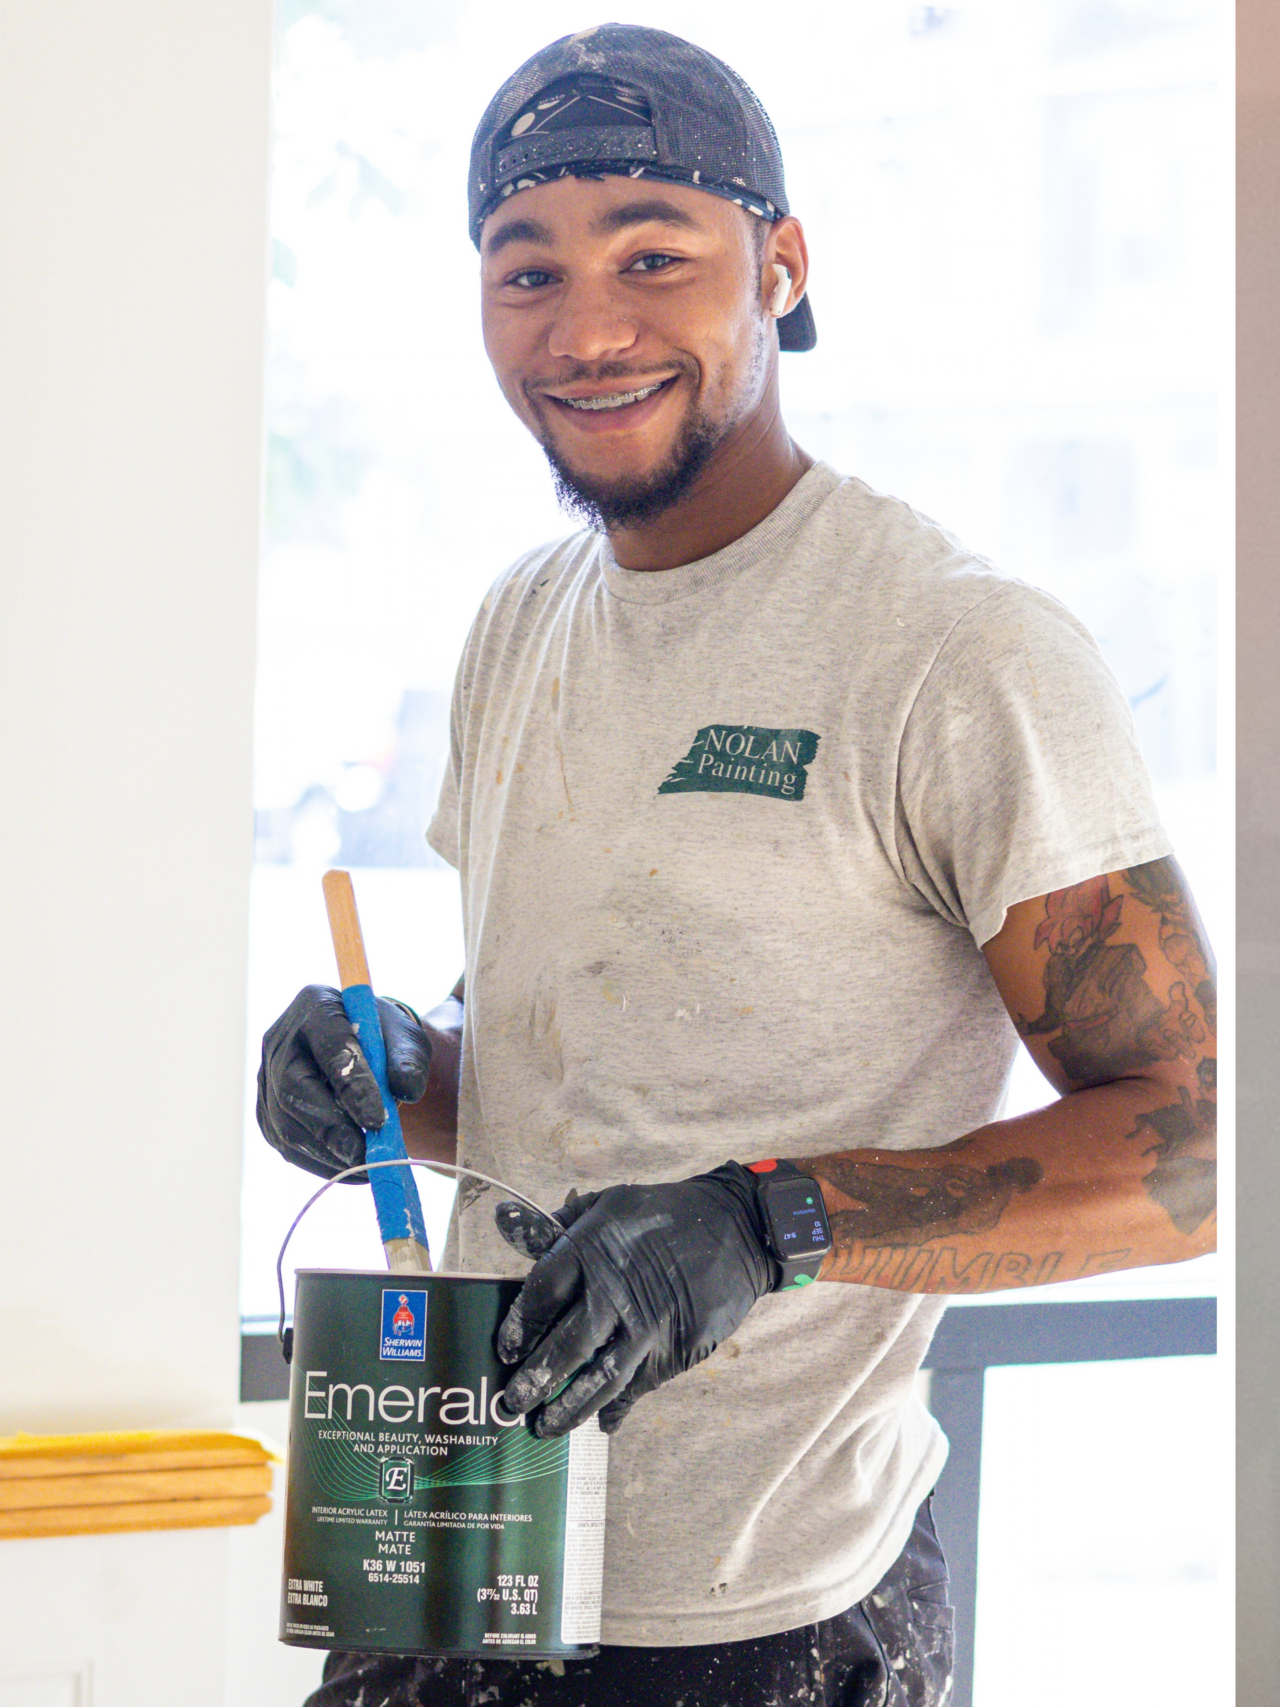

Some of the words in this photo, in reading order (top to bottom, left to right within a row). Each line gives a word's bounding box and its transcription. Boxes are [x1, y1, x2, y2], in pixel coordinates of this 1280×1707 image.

[704, 729, 801, 765] NOLAN
[698, 753, 797, 795] Painting
[384, 1337, 423, 1348] SHERWIN
[382, 1347, 423, 1358] WILLIAMS
[318, 1430, 375, 1442] EXCEPTIONAL
[379, 1432, 421, 1445] BEAUTY,
[425, 1434, 498, 1446] WASHABILITY
[353, 1443, 375, 1453] AND
[377, 1445, 448, 1456] APPLICATION
[311, 1506, 337, 1514] INTERIOR
[338, 1507, 365, 1516] ACRYLIC
[366, 1508, 388, 1517] LATEX
[468, 1512, 489, 1521] PARA
[490, 1513, 533, 1522] INTERIORES
[356, 1518, 388, 1526] WARRANTY
[437, 1521, 466, 1529] LIMITADA
[375, 1530, 416, 1543] MATTE
[378, 1543, 412, 1555] MATE
[363, 1559, 383, 1571] K36
[385, 1560, 397, 1572] W
[399, 1561, 426, 1573] 1051
[368, 1573, 420, 1584] 6514-25514
[497, 1575, 513, 1587] 123
[515, 1575, 526, 1587] FL
[528, 1575, 539, 1587] OZ
[288, 1578, 302, 1591] EXTRA
[303, 1580, 324, 1593] WHITE
[287, 1592, 302, 1605] EXTRA
[302, 1594, 328, 1607] BLANCO
[502, 1589, 522, 1601] U.S.
[524, 1589, 539, 1603] QT)
[511, 1603, 531, 1615] 3.63
[532, 1604, 538, 1615] L
